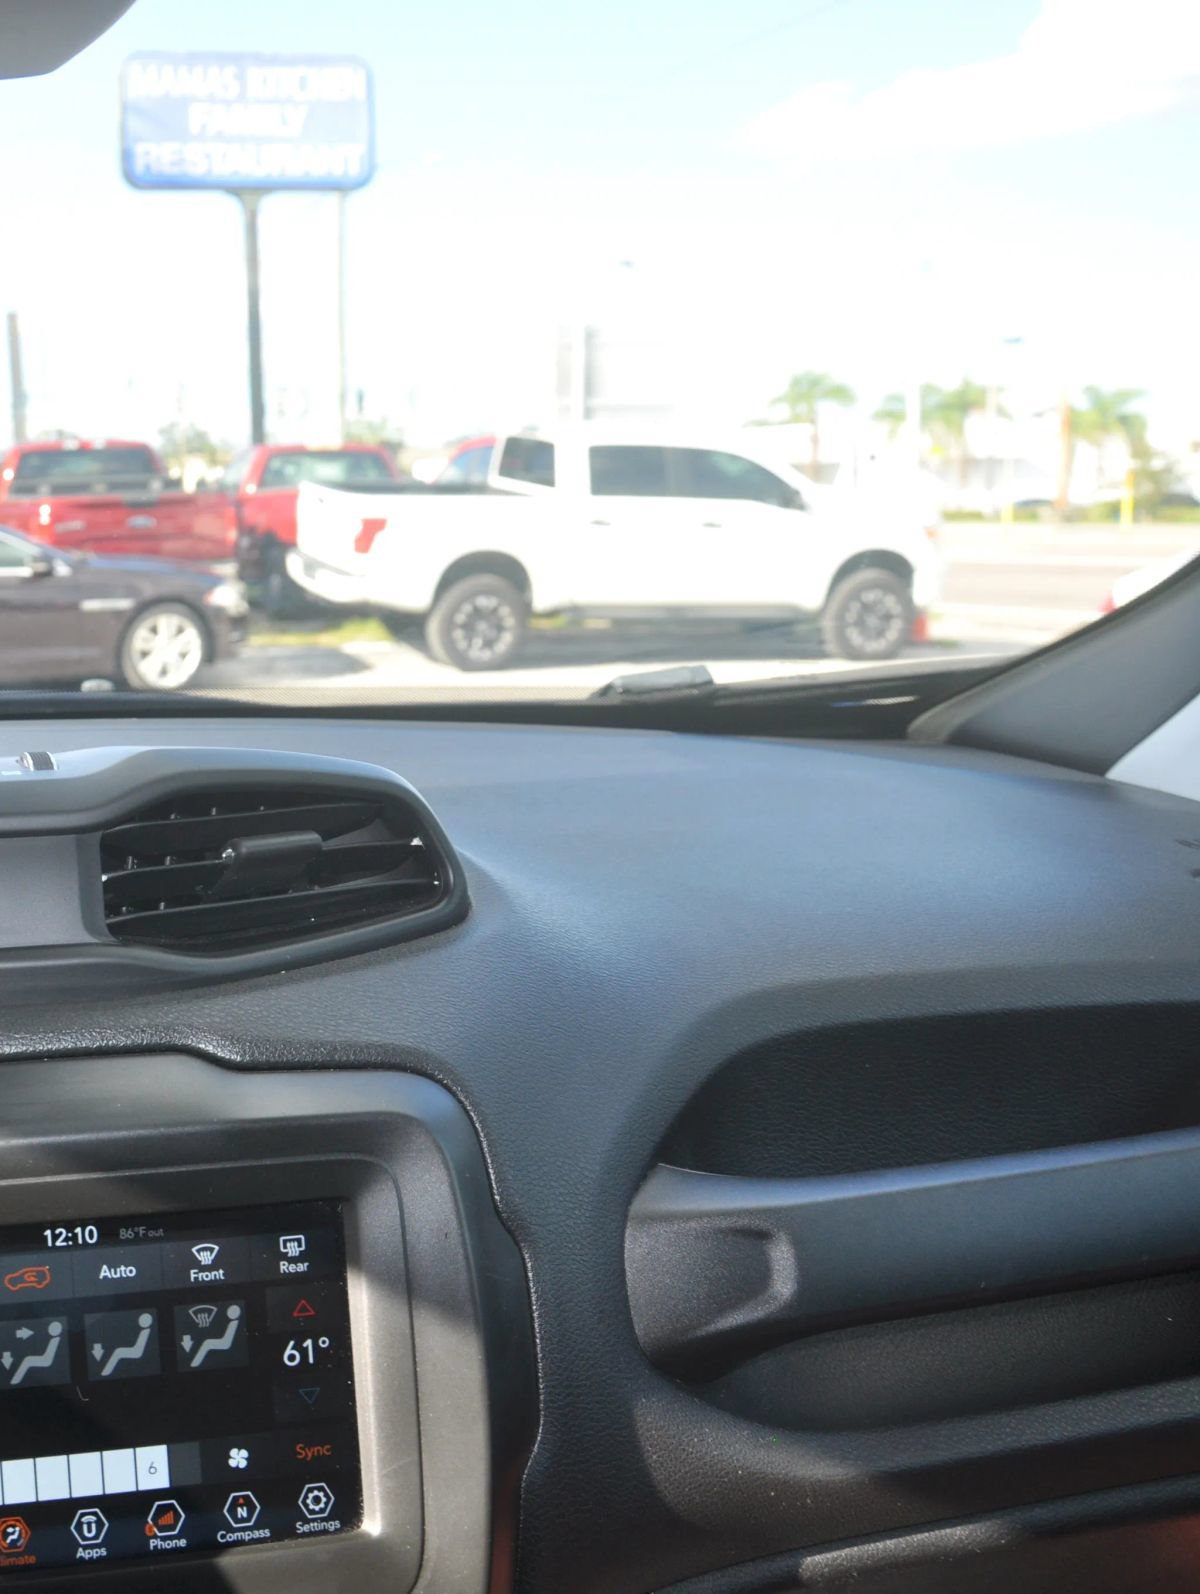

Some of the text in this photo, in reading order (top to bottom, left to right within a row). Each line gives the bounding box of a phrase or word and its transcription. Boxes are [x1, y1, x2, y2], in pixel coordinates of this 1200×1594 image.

[43, 1225, 98, 1247] 12:10
[98, 1263, 137, 1280] Auto
[189, 1267, 225, 1283] Front
[279, 1260, 309, 1274] Rear
[283, 1336, 330, 1367] 61°
[295, 1443, 332, 1462] Sync
[147, 1461, 158, 1476] 6
[236, 1505, 248, 1519] N
[295, 1517, 341, 1534] Settings
[149, 1535, 187, 1551] Phone
[216, 1526, 271, 1544] Compass
[76, 1545, 107, 1560] Apps
